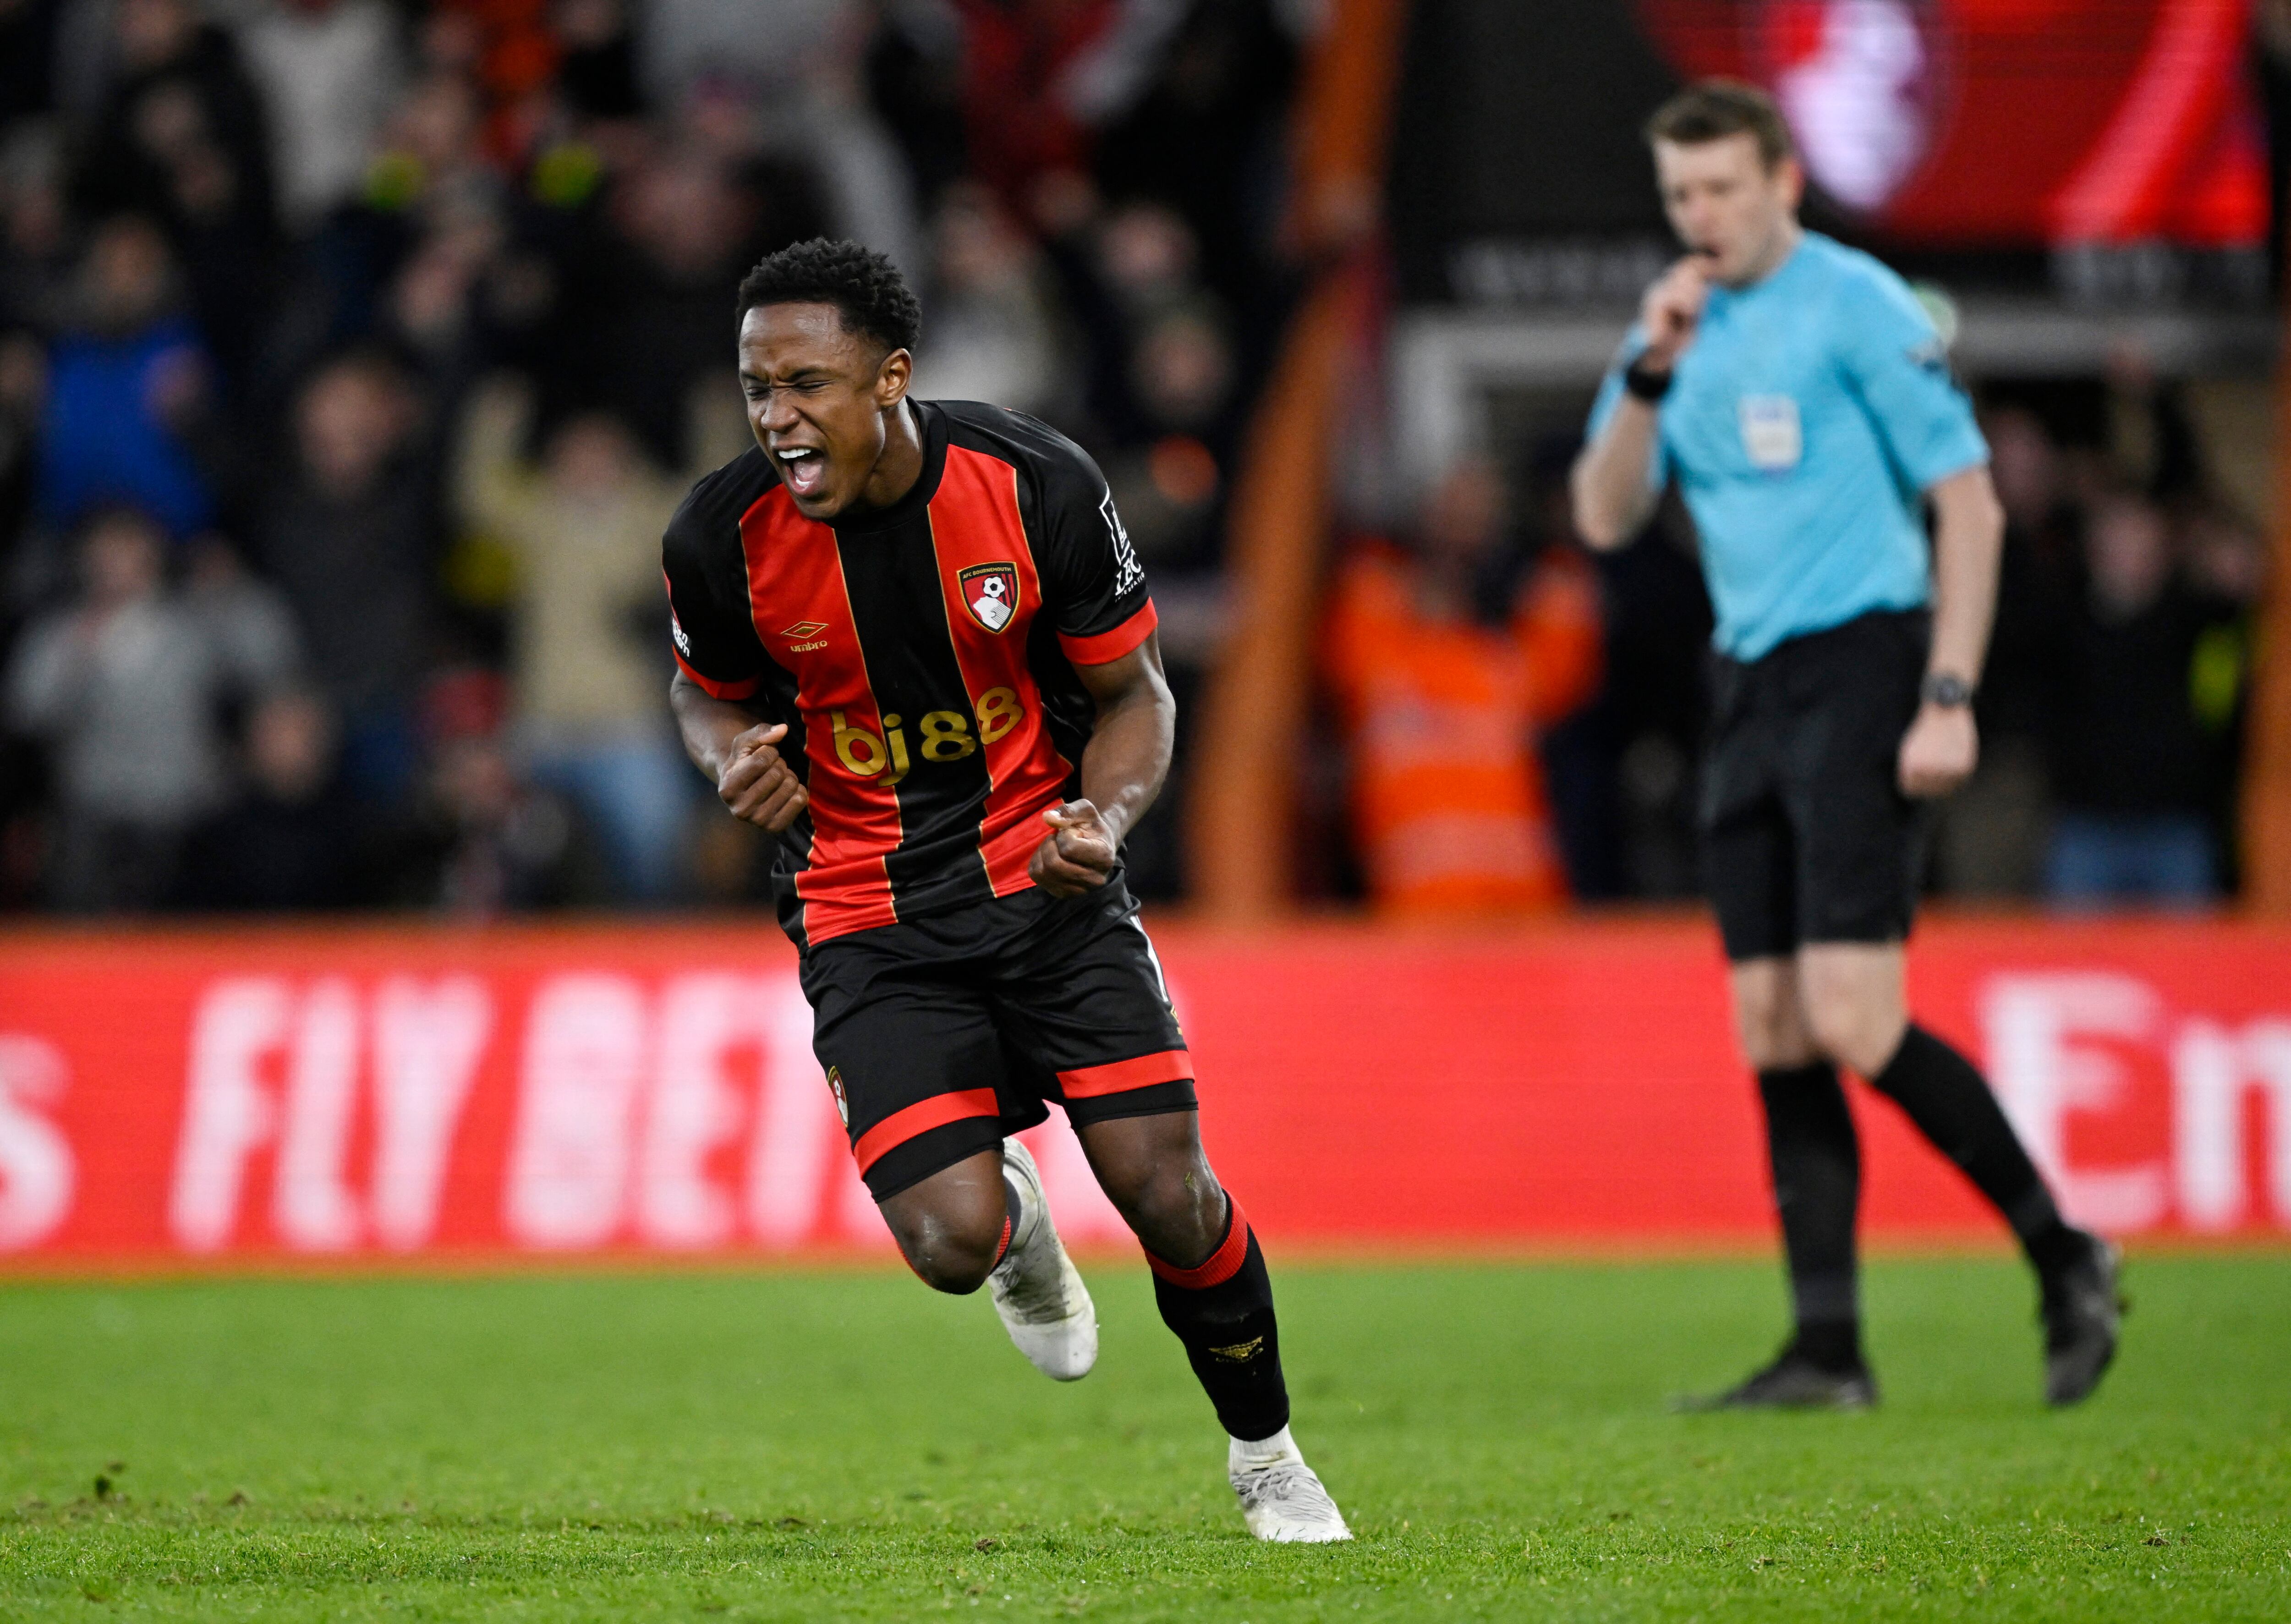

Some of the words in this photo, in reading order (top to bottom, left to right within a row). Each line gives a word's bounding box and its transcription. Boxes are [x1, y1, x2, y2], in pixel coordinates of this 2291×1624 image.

[973, 567, 1011, 575] BOURNEMOUTH
[790, 641, 828, 652] umbro
[830, 687, 1024, 787] bj88
[167, 971, 495, 1253] FLY
